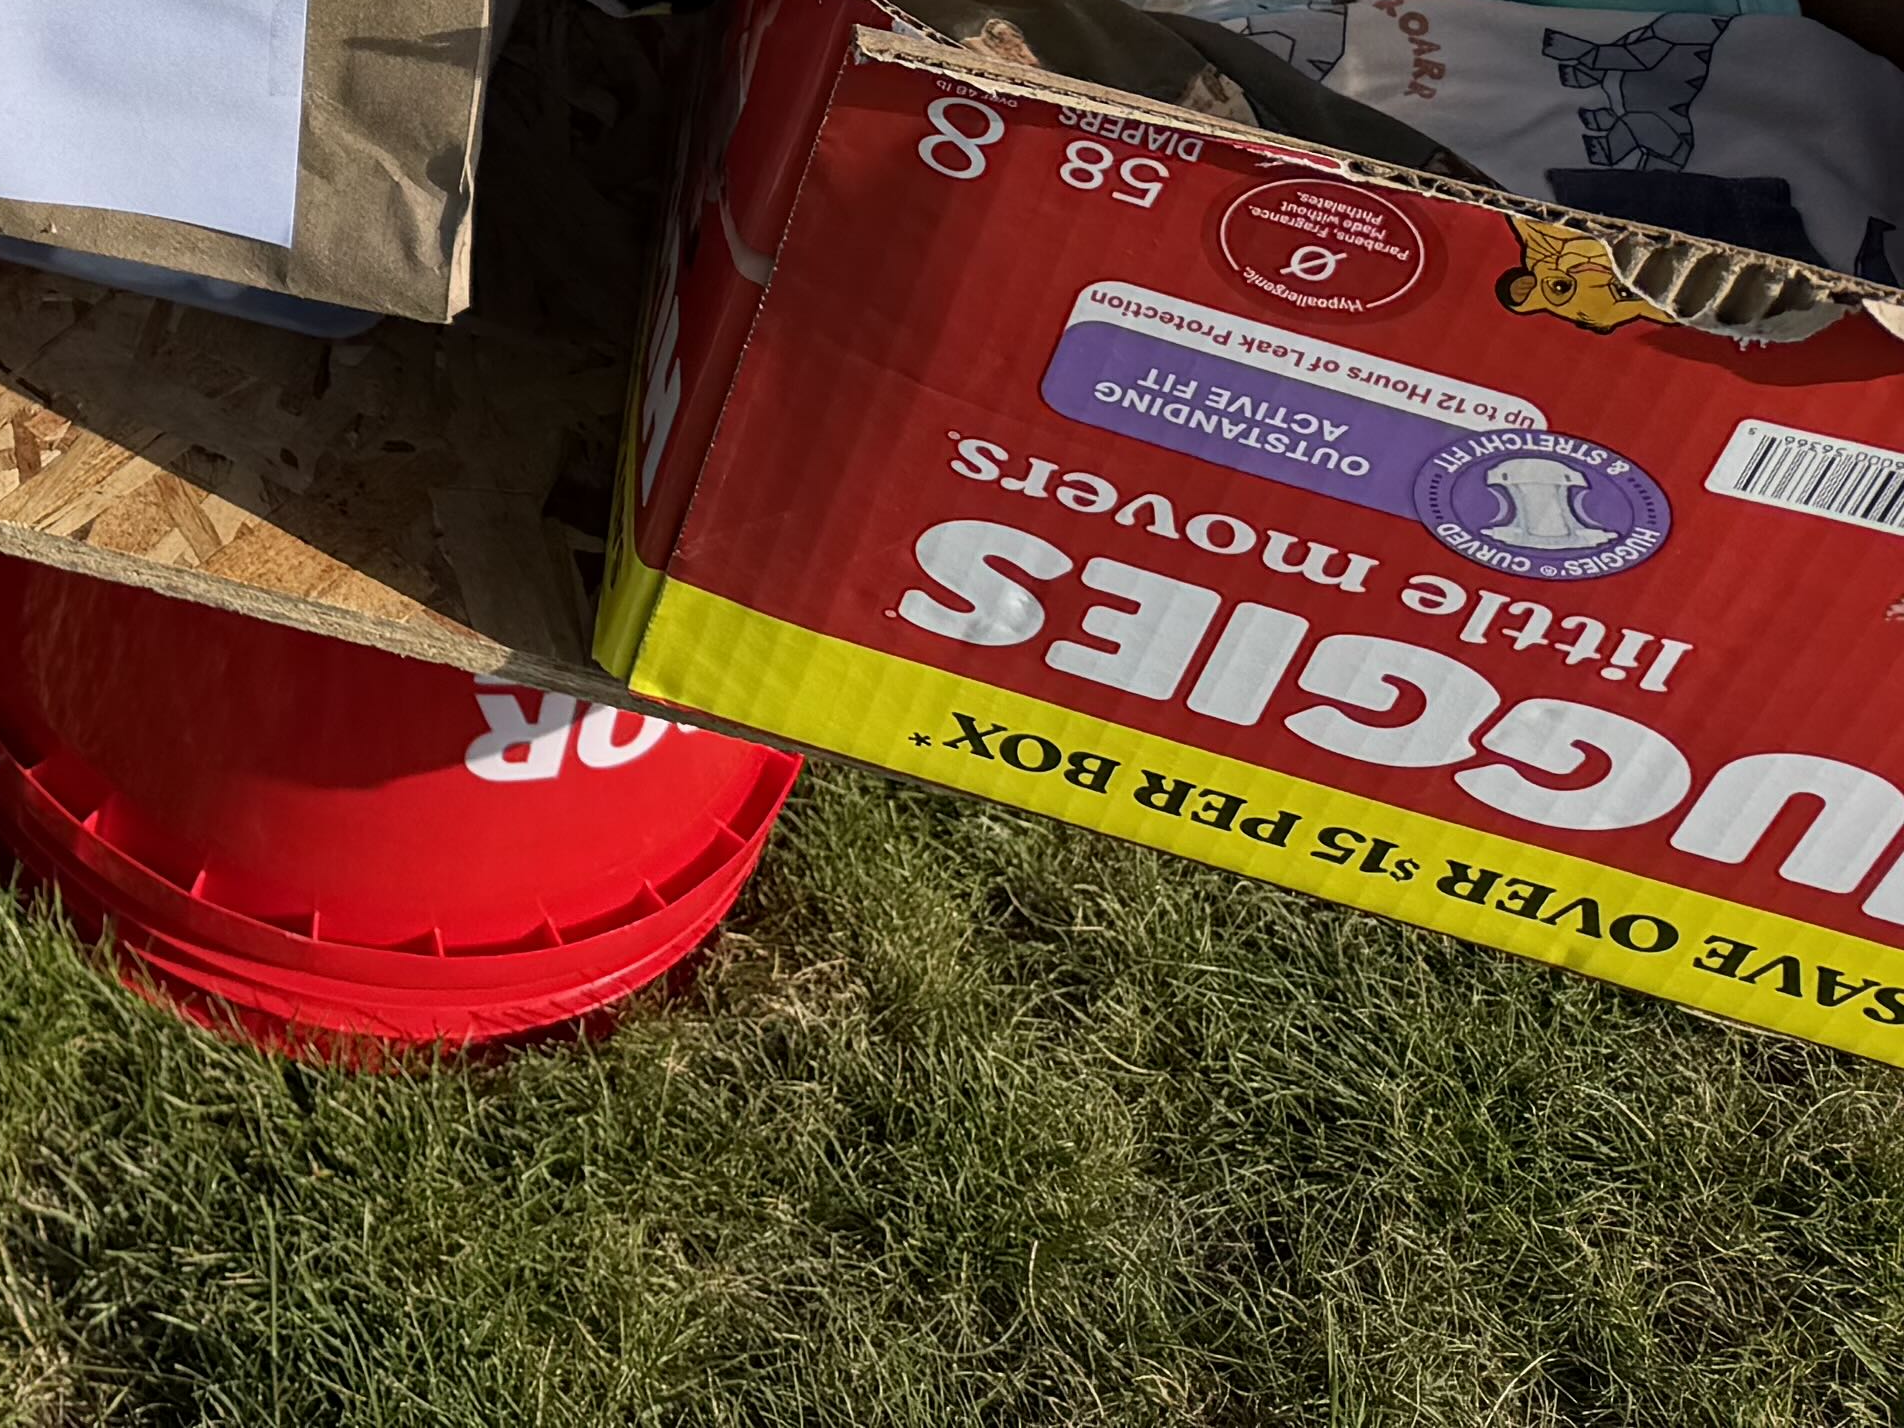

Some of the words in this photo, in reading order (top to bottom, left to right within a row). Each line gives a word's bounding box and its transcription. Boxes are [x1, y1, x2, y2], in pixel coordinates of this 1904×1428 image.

[917, 95, 1006, 181] 8
[1058, 106, 1205, 163] DIAPERS
[1059, 139, 1171, 209] 58
[1279, 200, 1343, 226] without
[1343, 216, 1387, 240] Made
[1333, 228, 1410, 262] Parabens,
[1088, 287, 1232, 349] Protection
[1237, 330, 1308, 370] Leak
[1310, 354, 1341, 375] of
[1136, 366, 1196, 401] FIT
[1346, 364, 1433, 407] Hours
[1438, 390, 1468, 416] 12
[1093, 380, 1372, 479] OUTSTANDING
[1206, 385, 1350, 444] ACTIVE
[1470, 401, 1499, 425] to
[1433, 445, 1469, 475] FIT
[1464, 430, 1609, 465] STRETCHY
[1435, 522, 1533, 575] CURVED
[1401, 574, 1695, 694] little
[1132, 768, 1305, 850] PER
[1309, 824, 1422, 883] $15
[1435, 856, 1682, 957] OVER
[1691, 933, 1904, 1028] SAVE
